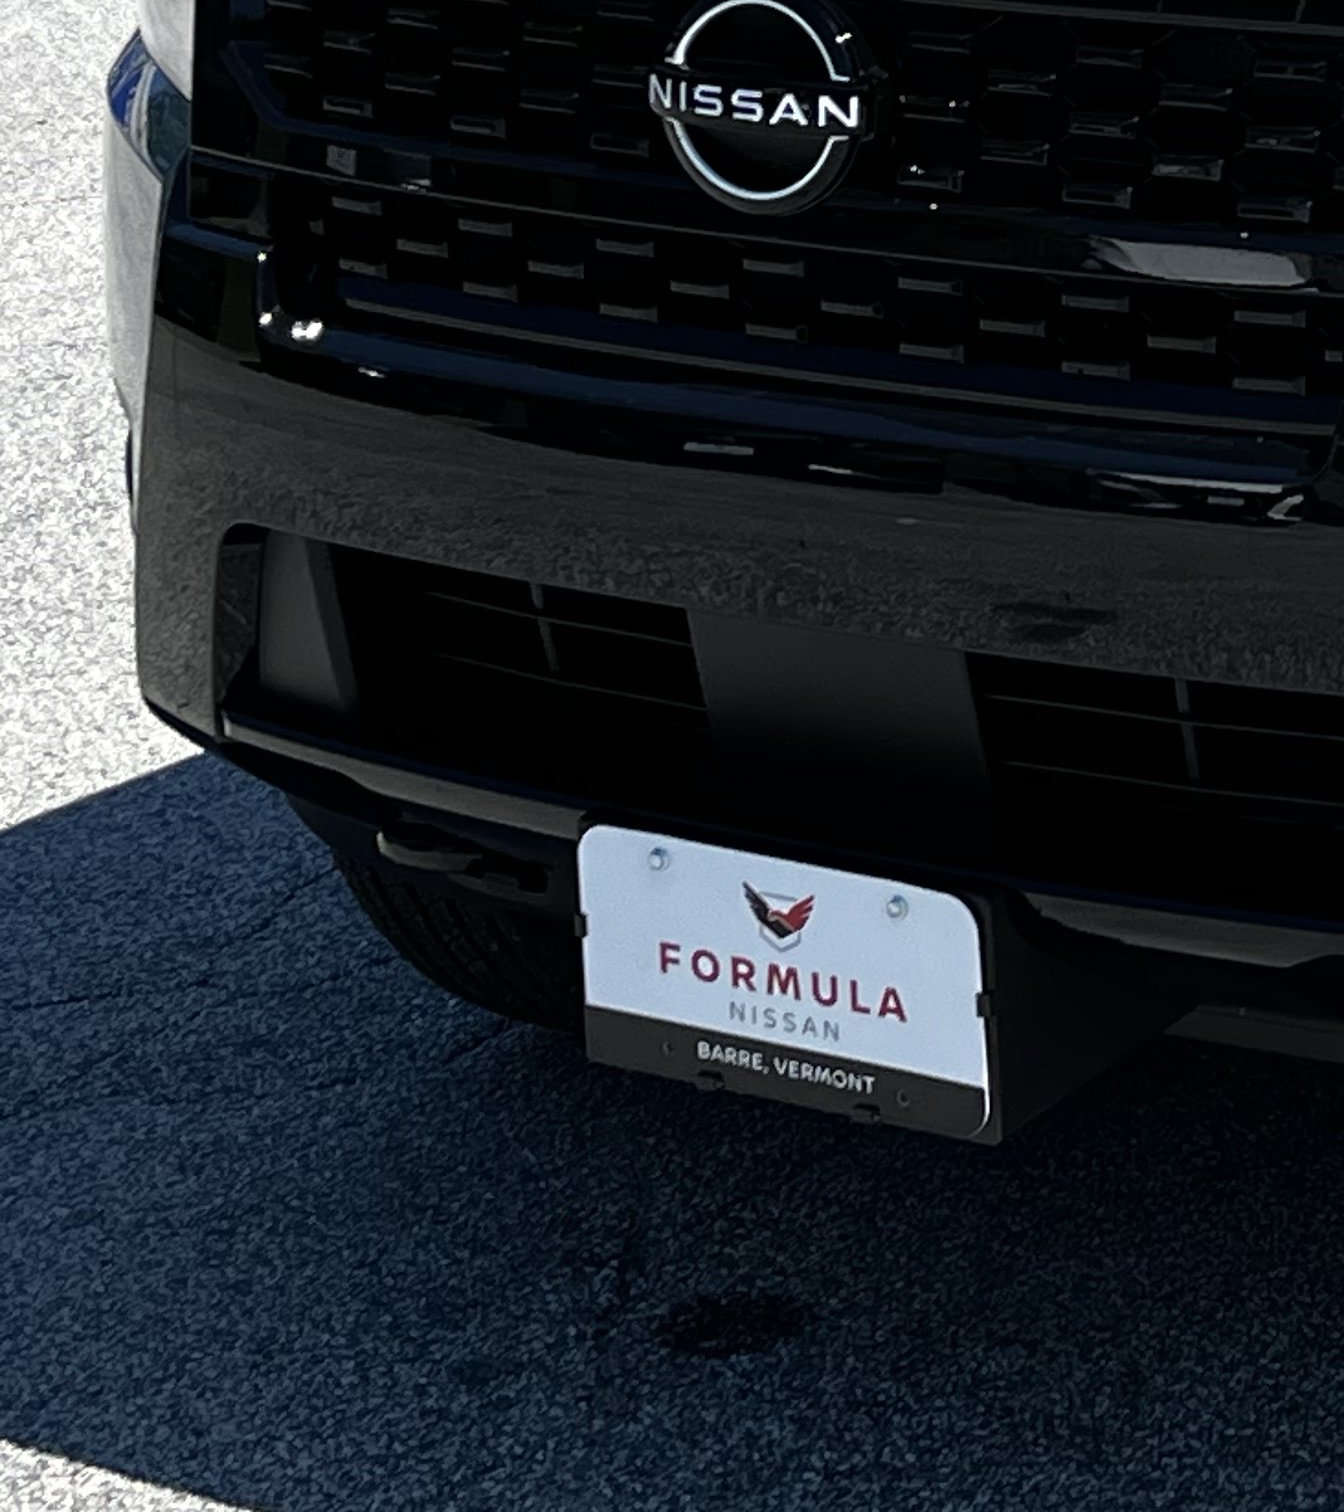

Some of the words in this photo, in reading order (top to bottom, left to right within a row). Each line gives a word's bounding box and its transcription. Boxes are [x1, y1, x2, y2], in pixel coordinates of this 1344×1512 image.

[648, 72, 860, 129] NISSAN
[658, 941, 908, 1023] FORMULA
[729, 1000, 841, 1043] NISSAN
[697, 1040, 768, 1075] BARRE,
[774, 1057, 875, 1095] VERMONT
